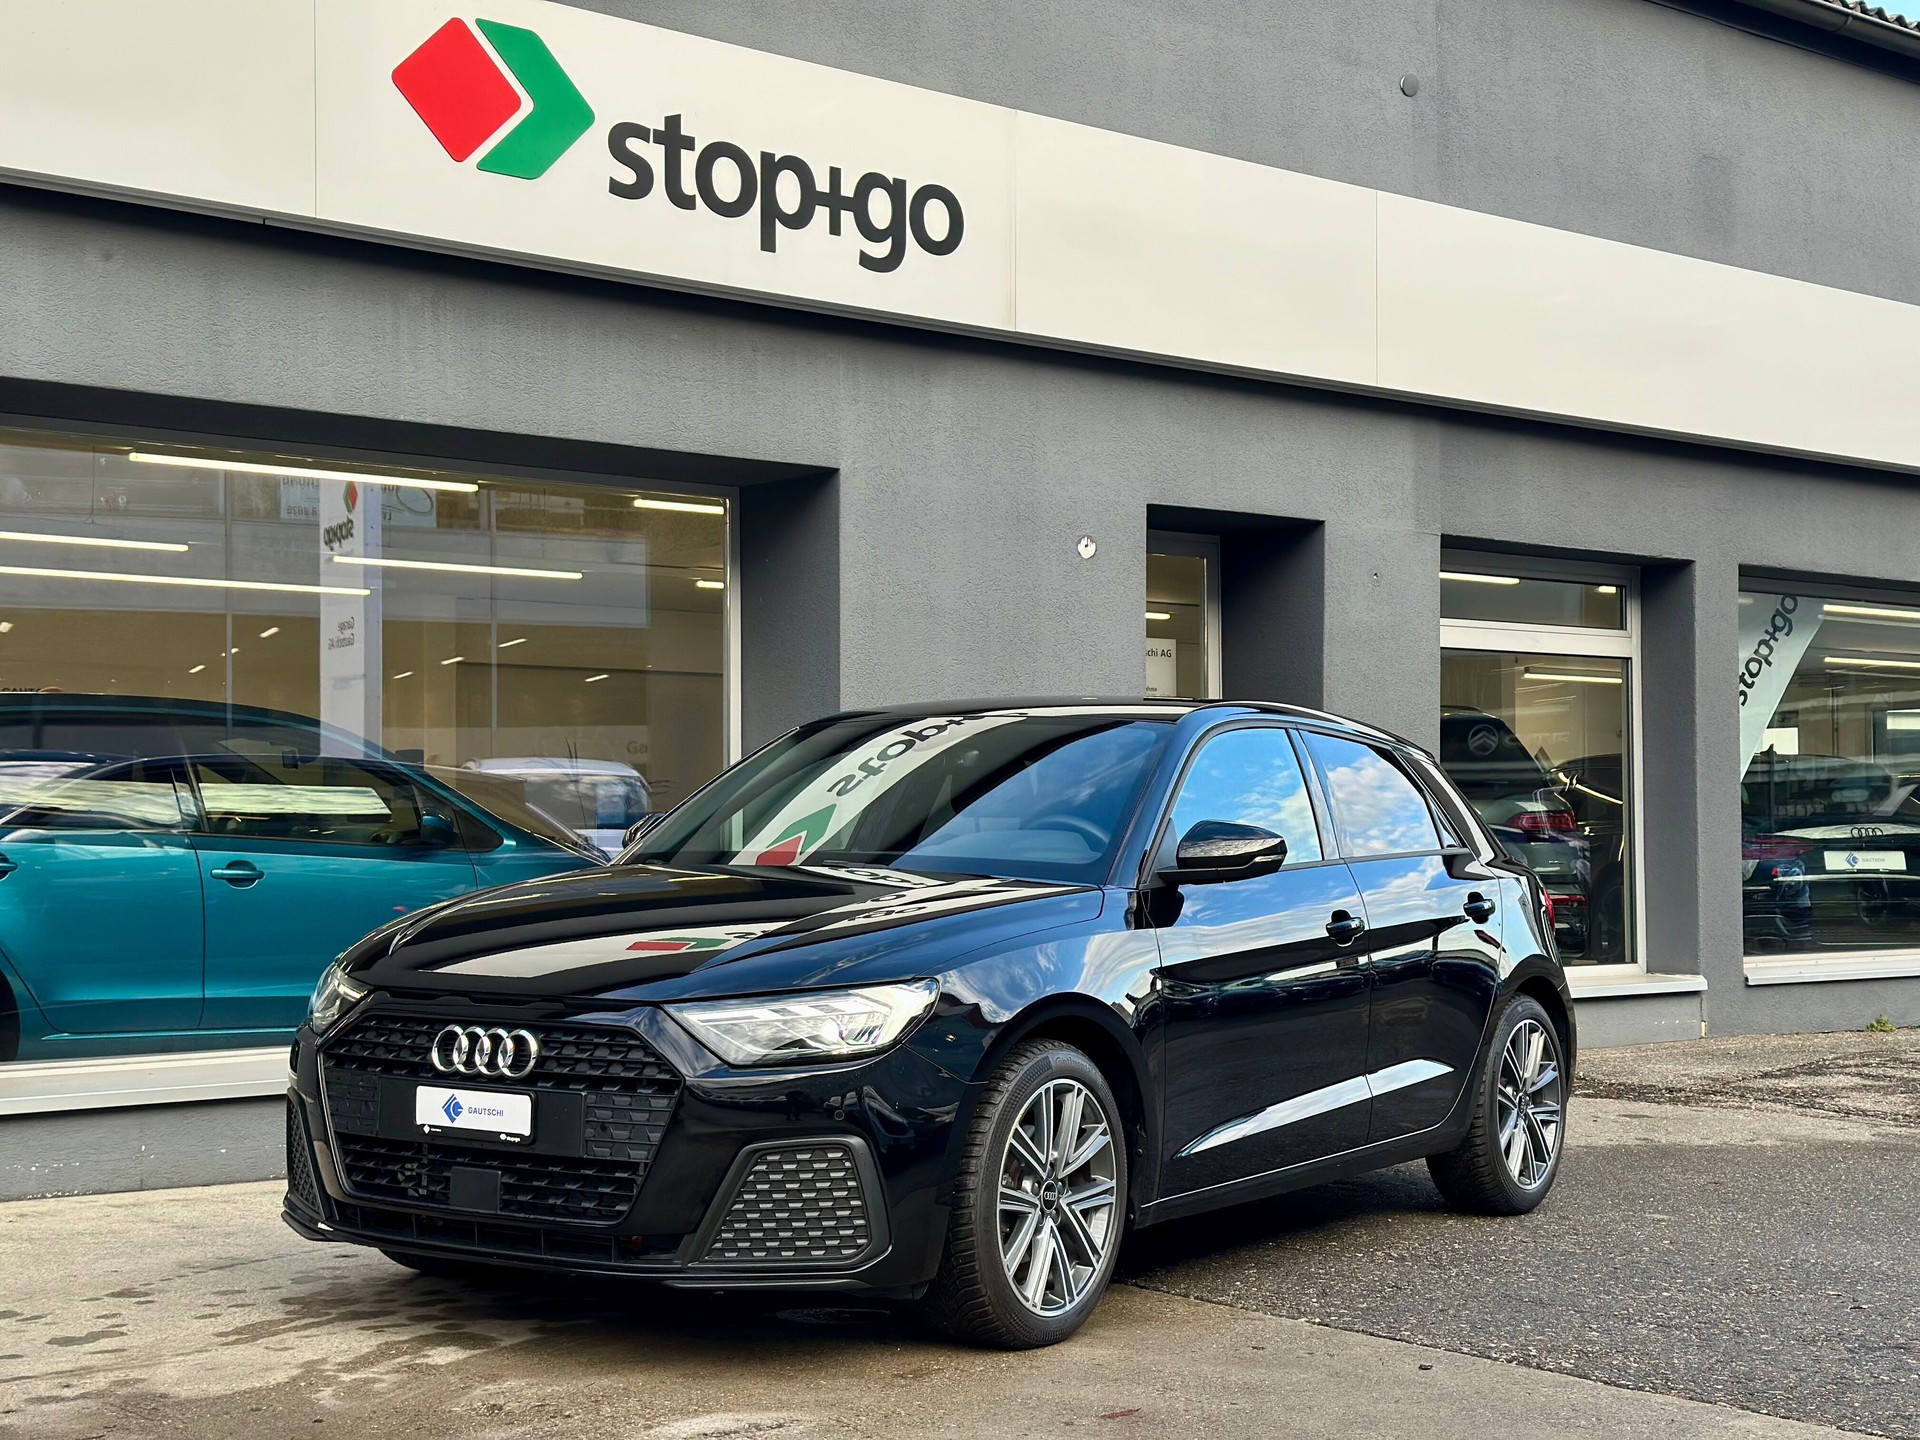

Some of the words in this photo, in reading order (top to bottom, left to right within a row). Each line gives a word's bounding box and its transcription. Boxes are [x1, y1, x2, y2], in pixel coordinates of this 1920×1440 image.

[607, 113, 965, 273] stop+go
[1146, 648, 1158, 656] chi
[1160, 649, 1172, 658] AG
[467, 1106, 504, 1117] GAUTSCHI
